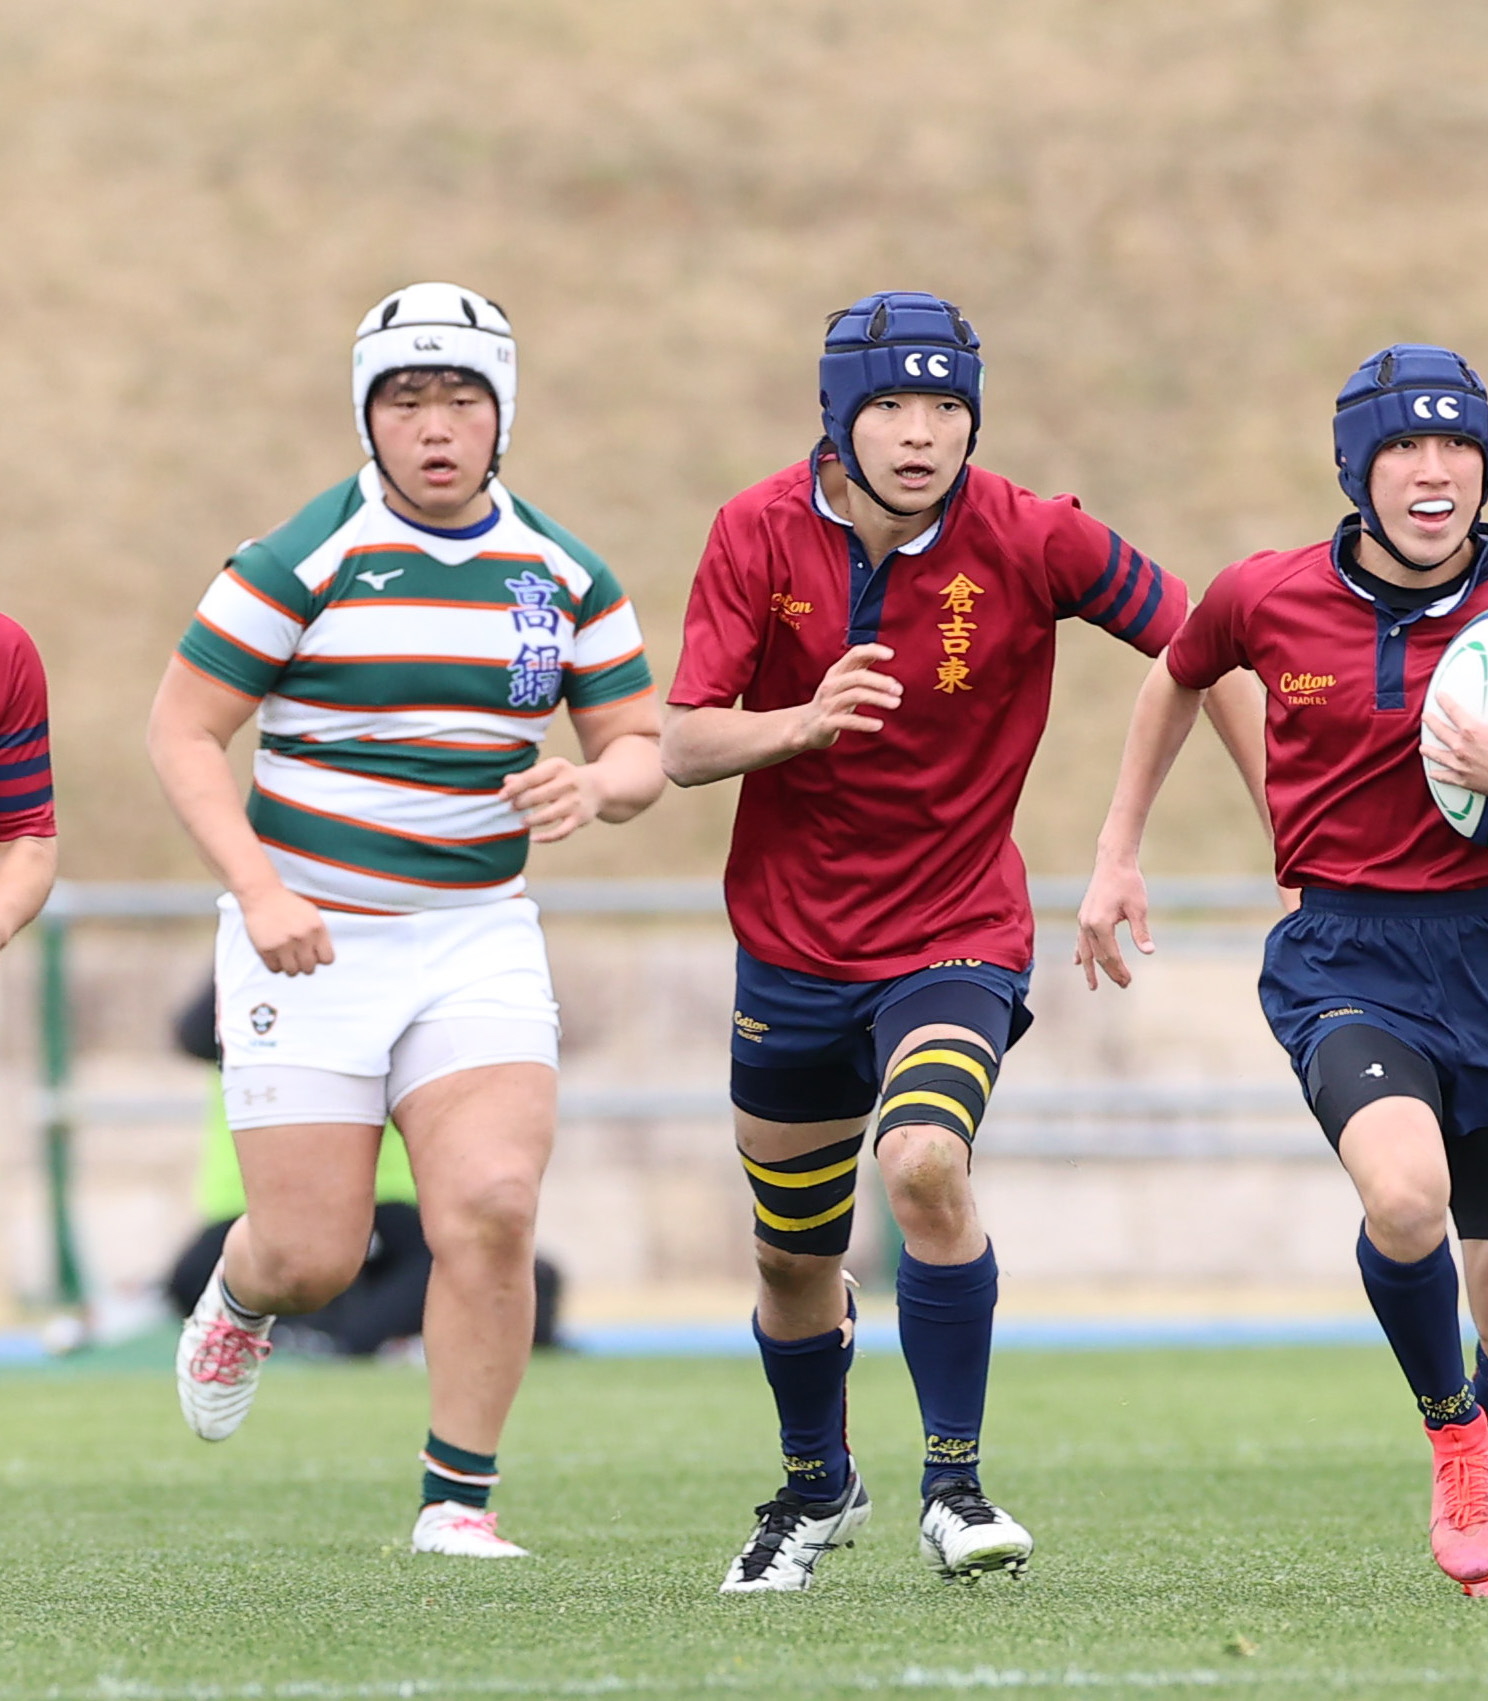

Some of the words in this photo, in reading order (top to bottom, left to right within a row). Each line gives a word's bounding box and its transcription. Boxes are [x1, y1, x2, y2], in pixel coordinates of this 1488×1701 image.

[933, 572, 985, 694] 倉吉東
[1280, 671, 1337, 694] Cotton
[1287, 695, 1328, 706] TRADERS
[734, 1010, 770, 1031] Cotton
